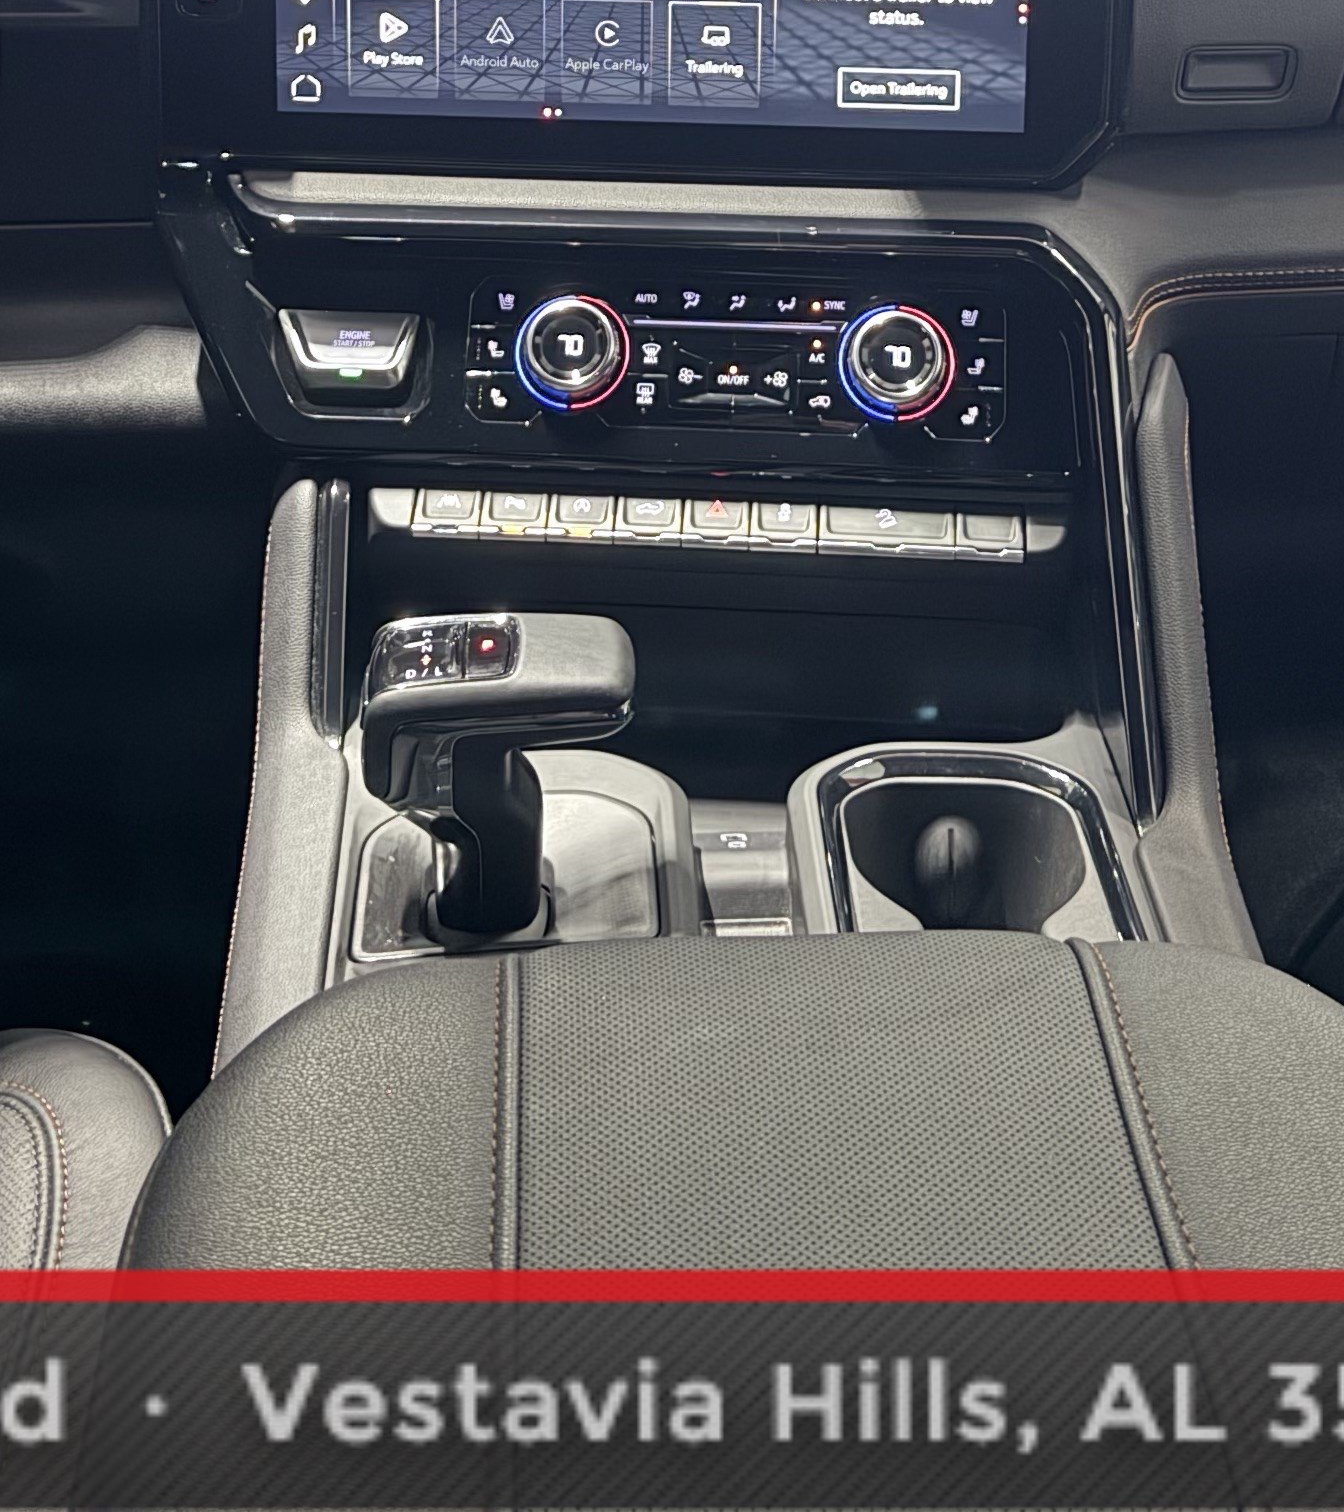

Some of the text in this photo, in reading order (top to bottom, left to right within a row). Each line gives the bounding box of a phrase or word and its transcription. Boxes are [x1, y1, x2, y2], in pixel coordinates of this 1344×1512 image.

[869, 7, 925, 26] status.
[363, 51, 424, 67] Play Store
[460, 54, 540, 70] Android Auto
[564, 57, 650, 76] Apple CarPlay
[685, 59, 745, 78] Trailering
[849, 80, 949, 101] Open Trailering
[634, 293, 658, 304] AUTO
[823, 300, 846, 310] SYNC
[338, 330, 372, 340] ENGINE
[358, 340, 376, 348] STOP
[557, 334, 585, 357] 70
[808, 352, 826, 363] A/C
[884, 344, 912, 369] 70
[717, 374, 750, 387] ON/OFF
